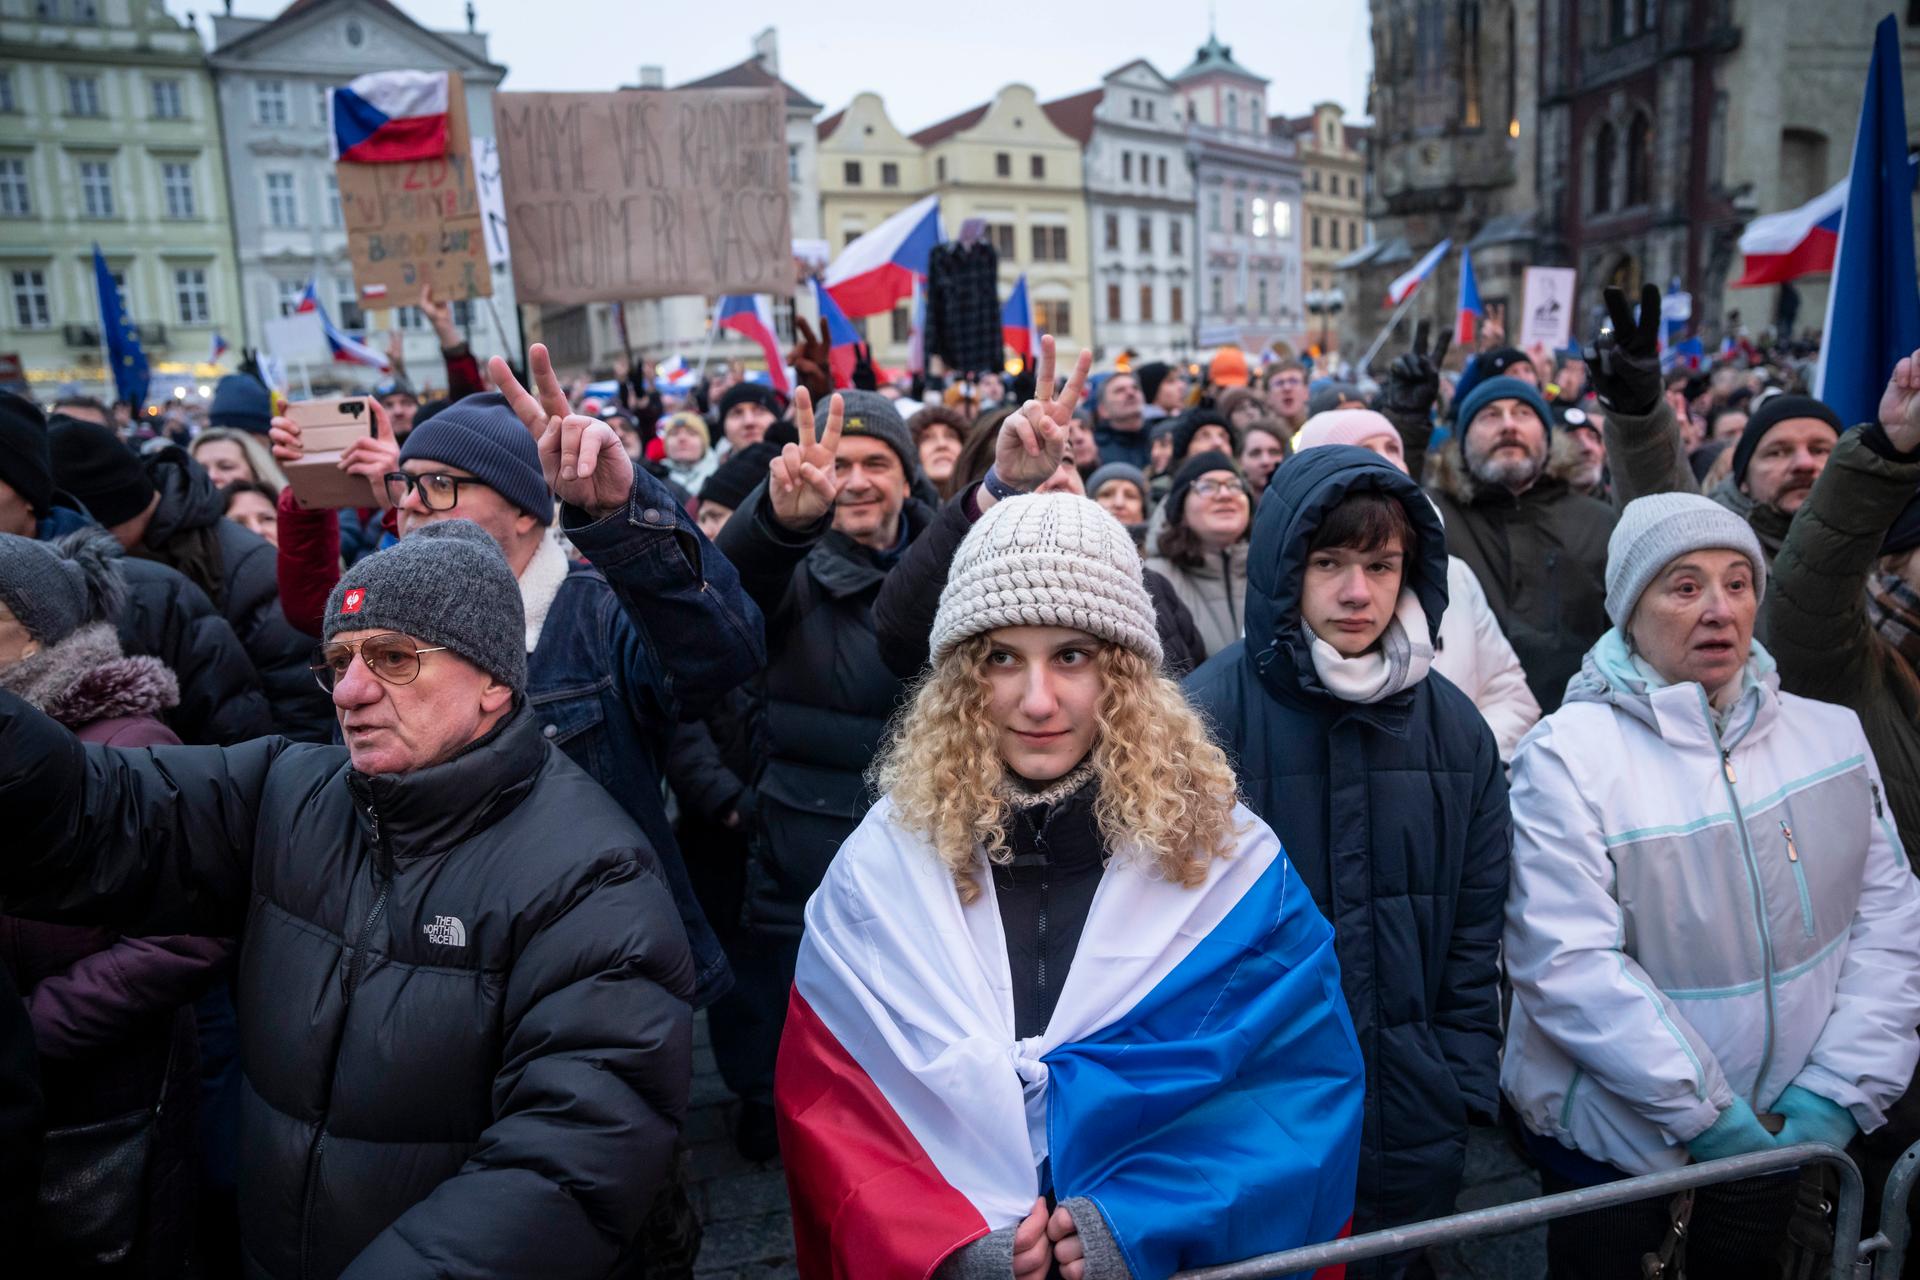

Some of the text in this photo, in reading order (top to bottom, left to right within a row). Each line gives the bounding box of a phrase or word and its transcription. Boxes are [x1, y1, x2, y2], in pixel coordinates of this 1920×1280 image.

[435, 915, 452, 926] THE
[423, 924, 450, 936] NORTH
[429, 934, 450, 945] FACE
